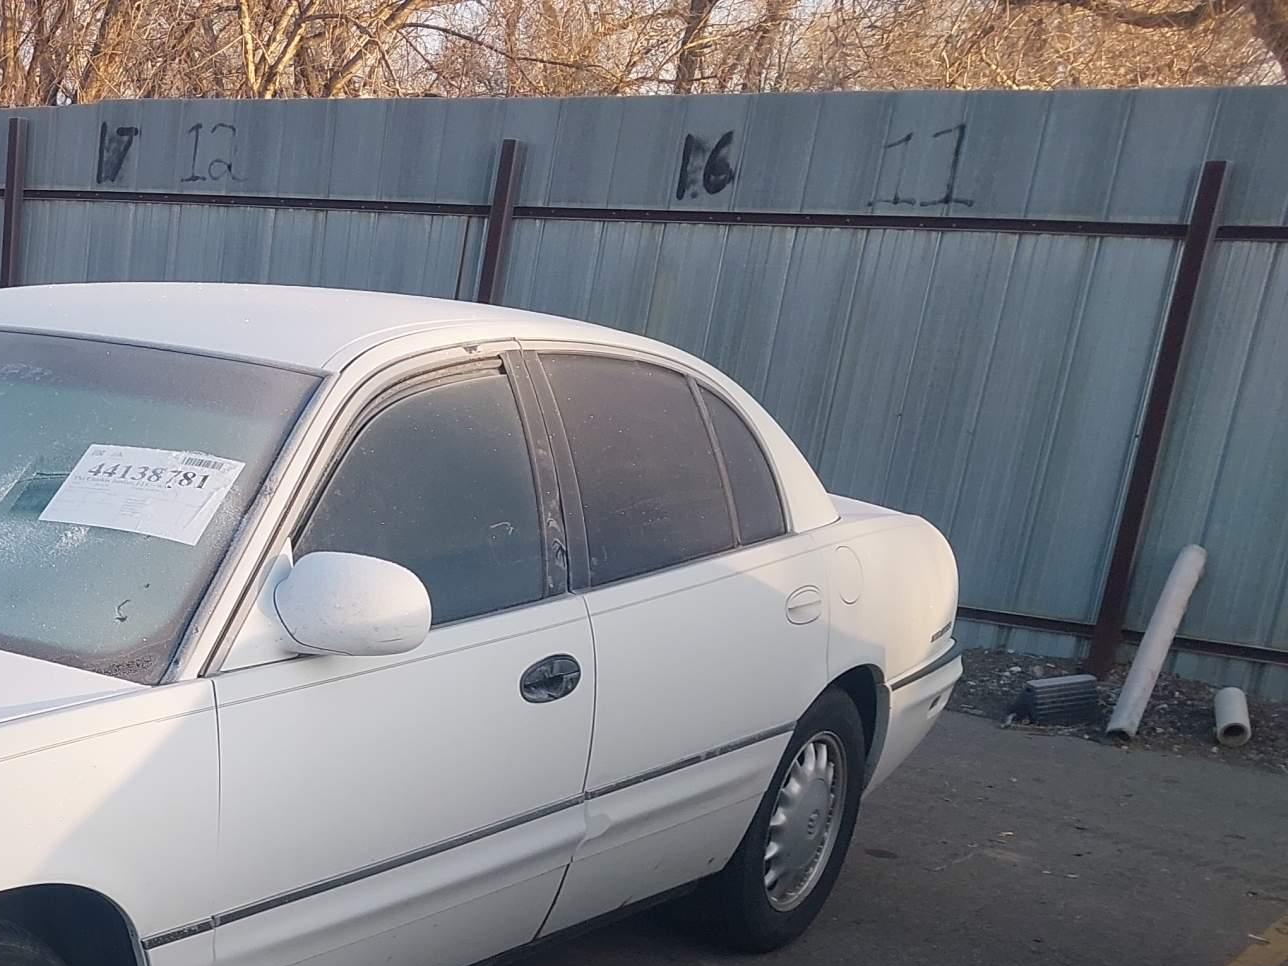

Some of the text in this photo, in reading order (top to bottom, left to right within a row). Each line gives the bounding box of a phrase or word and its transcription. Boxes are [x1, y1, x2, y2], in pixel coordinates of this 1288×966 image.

[181, 122, 246, 183] 12
[866, 123, 975, 208] 11
[87, 461, 211, 490] 44138781
